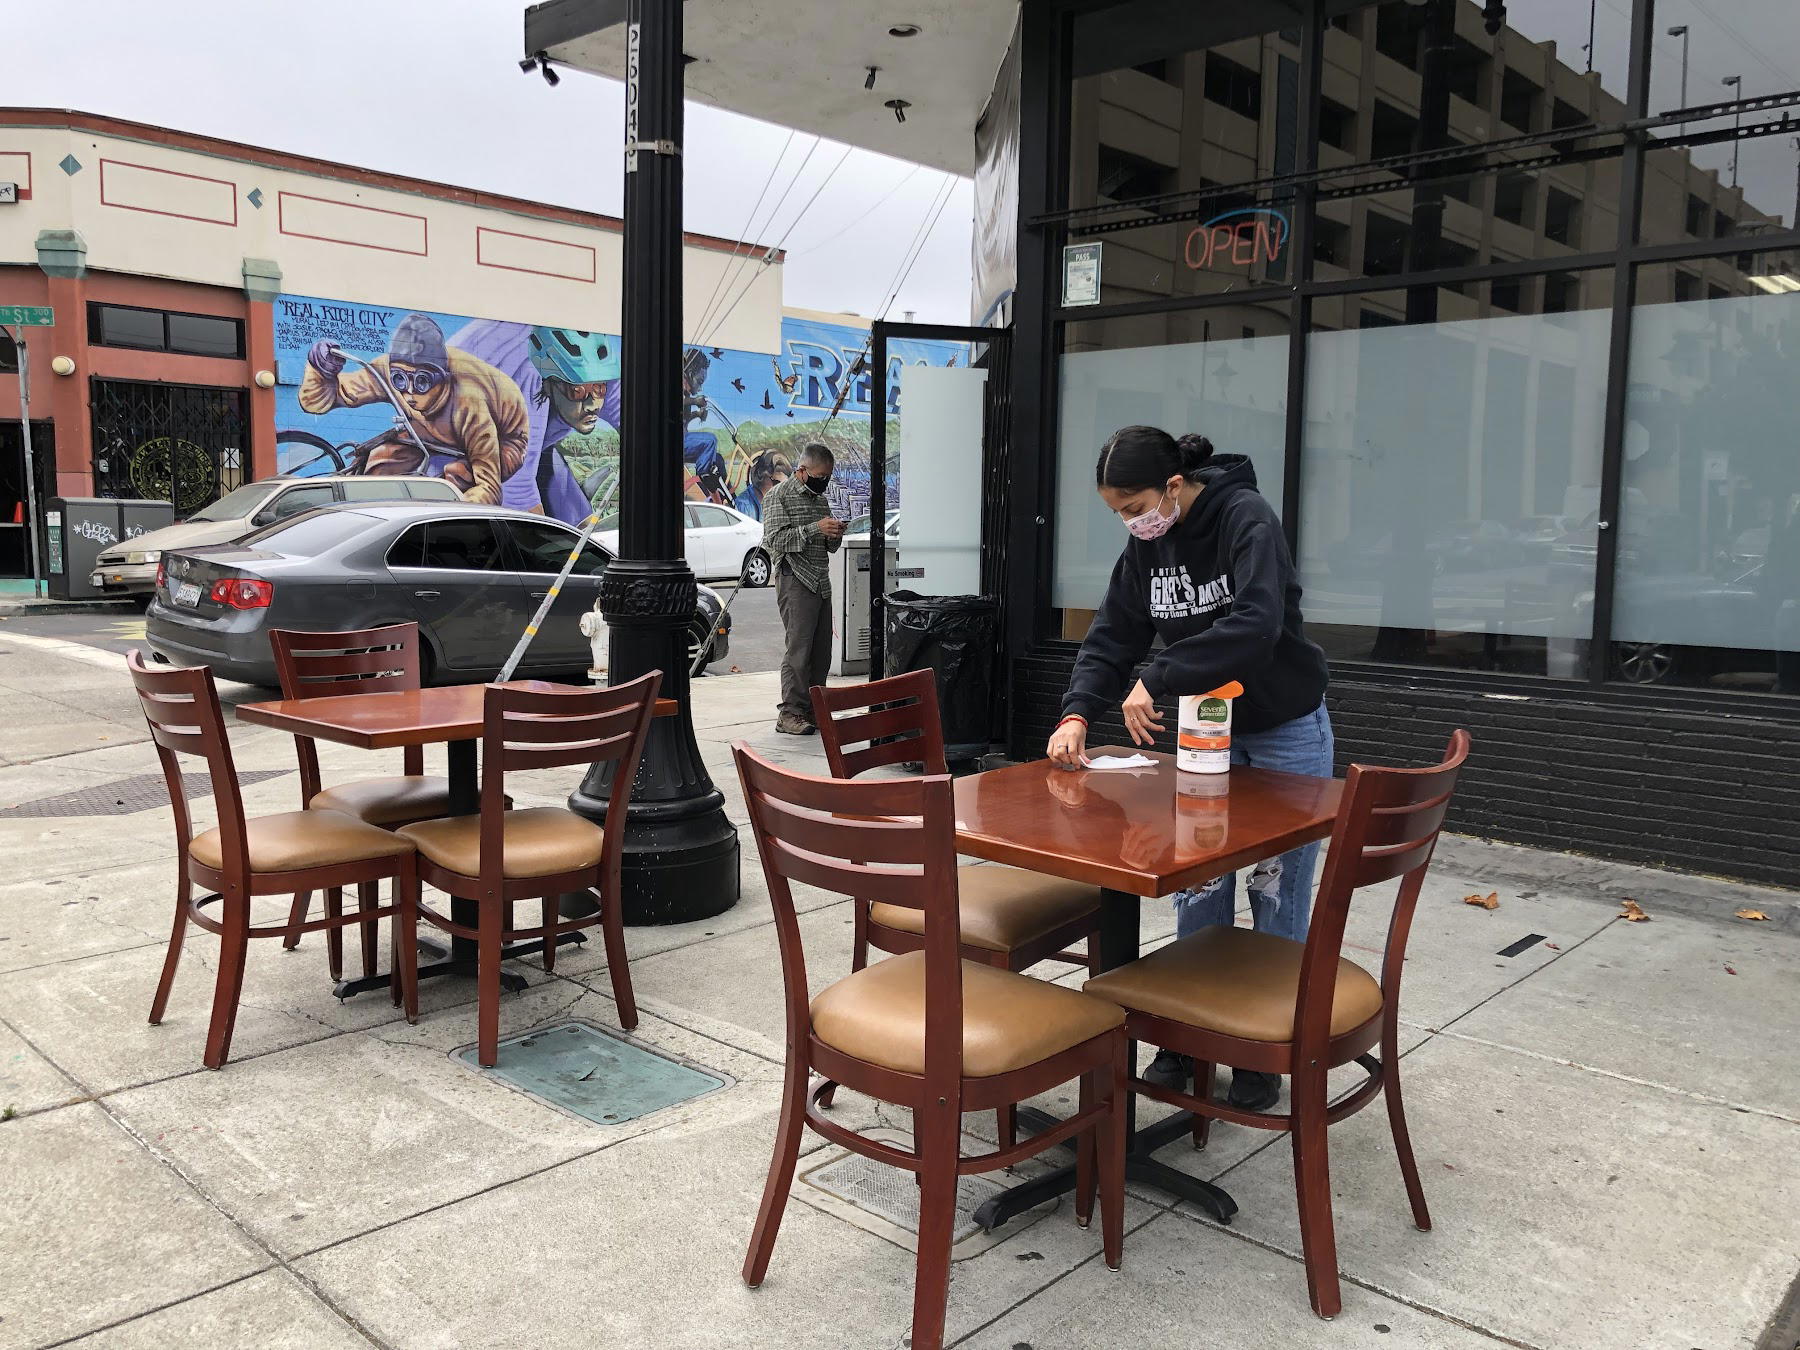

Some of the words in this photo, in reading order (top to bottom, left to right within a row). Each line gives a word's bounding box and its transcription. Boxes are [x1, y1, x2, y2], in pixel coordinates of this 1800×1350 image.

[1185, 220, 1282, 269] OPEN
[1075, 252, 1091, 262] PASS
[14, 308, 30, 323] St
[320, 305, 354, 324] RICH
[786, 339, 903, 415] REA
[895, 570, 915, 578] Smoking
